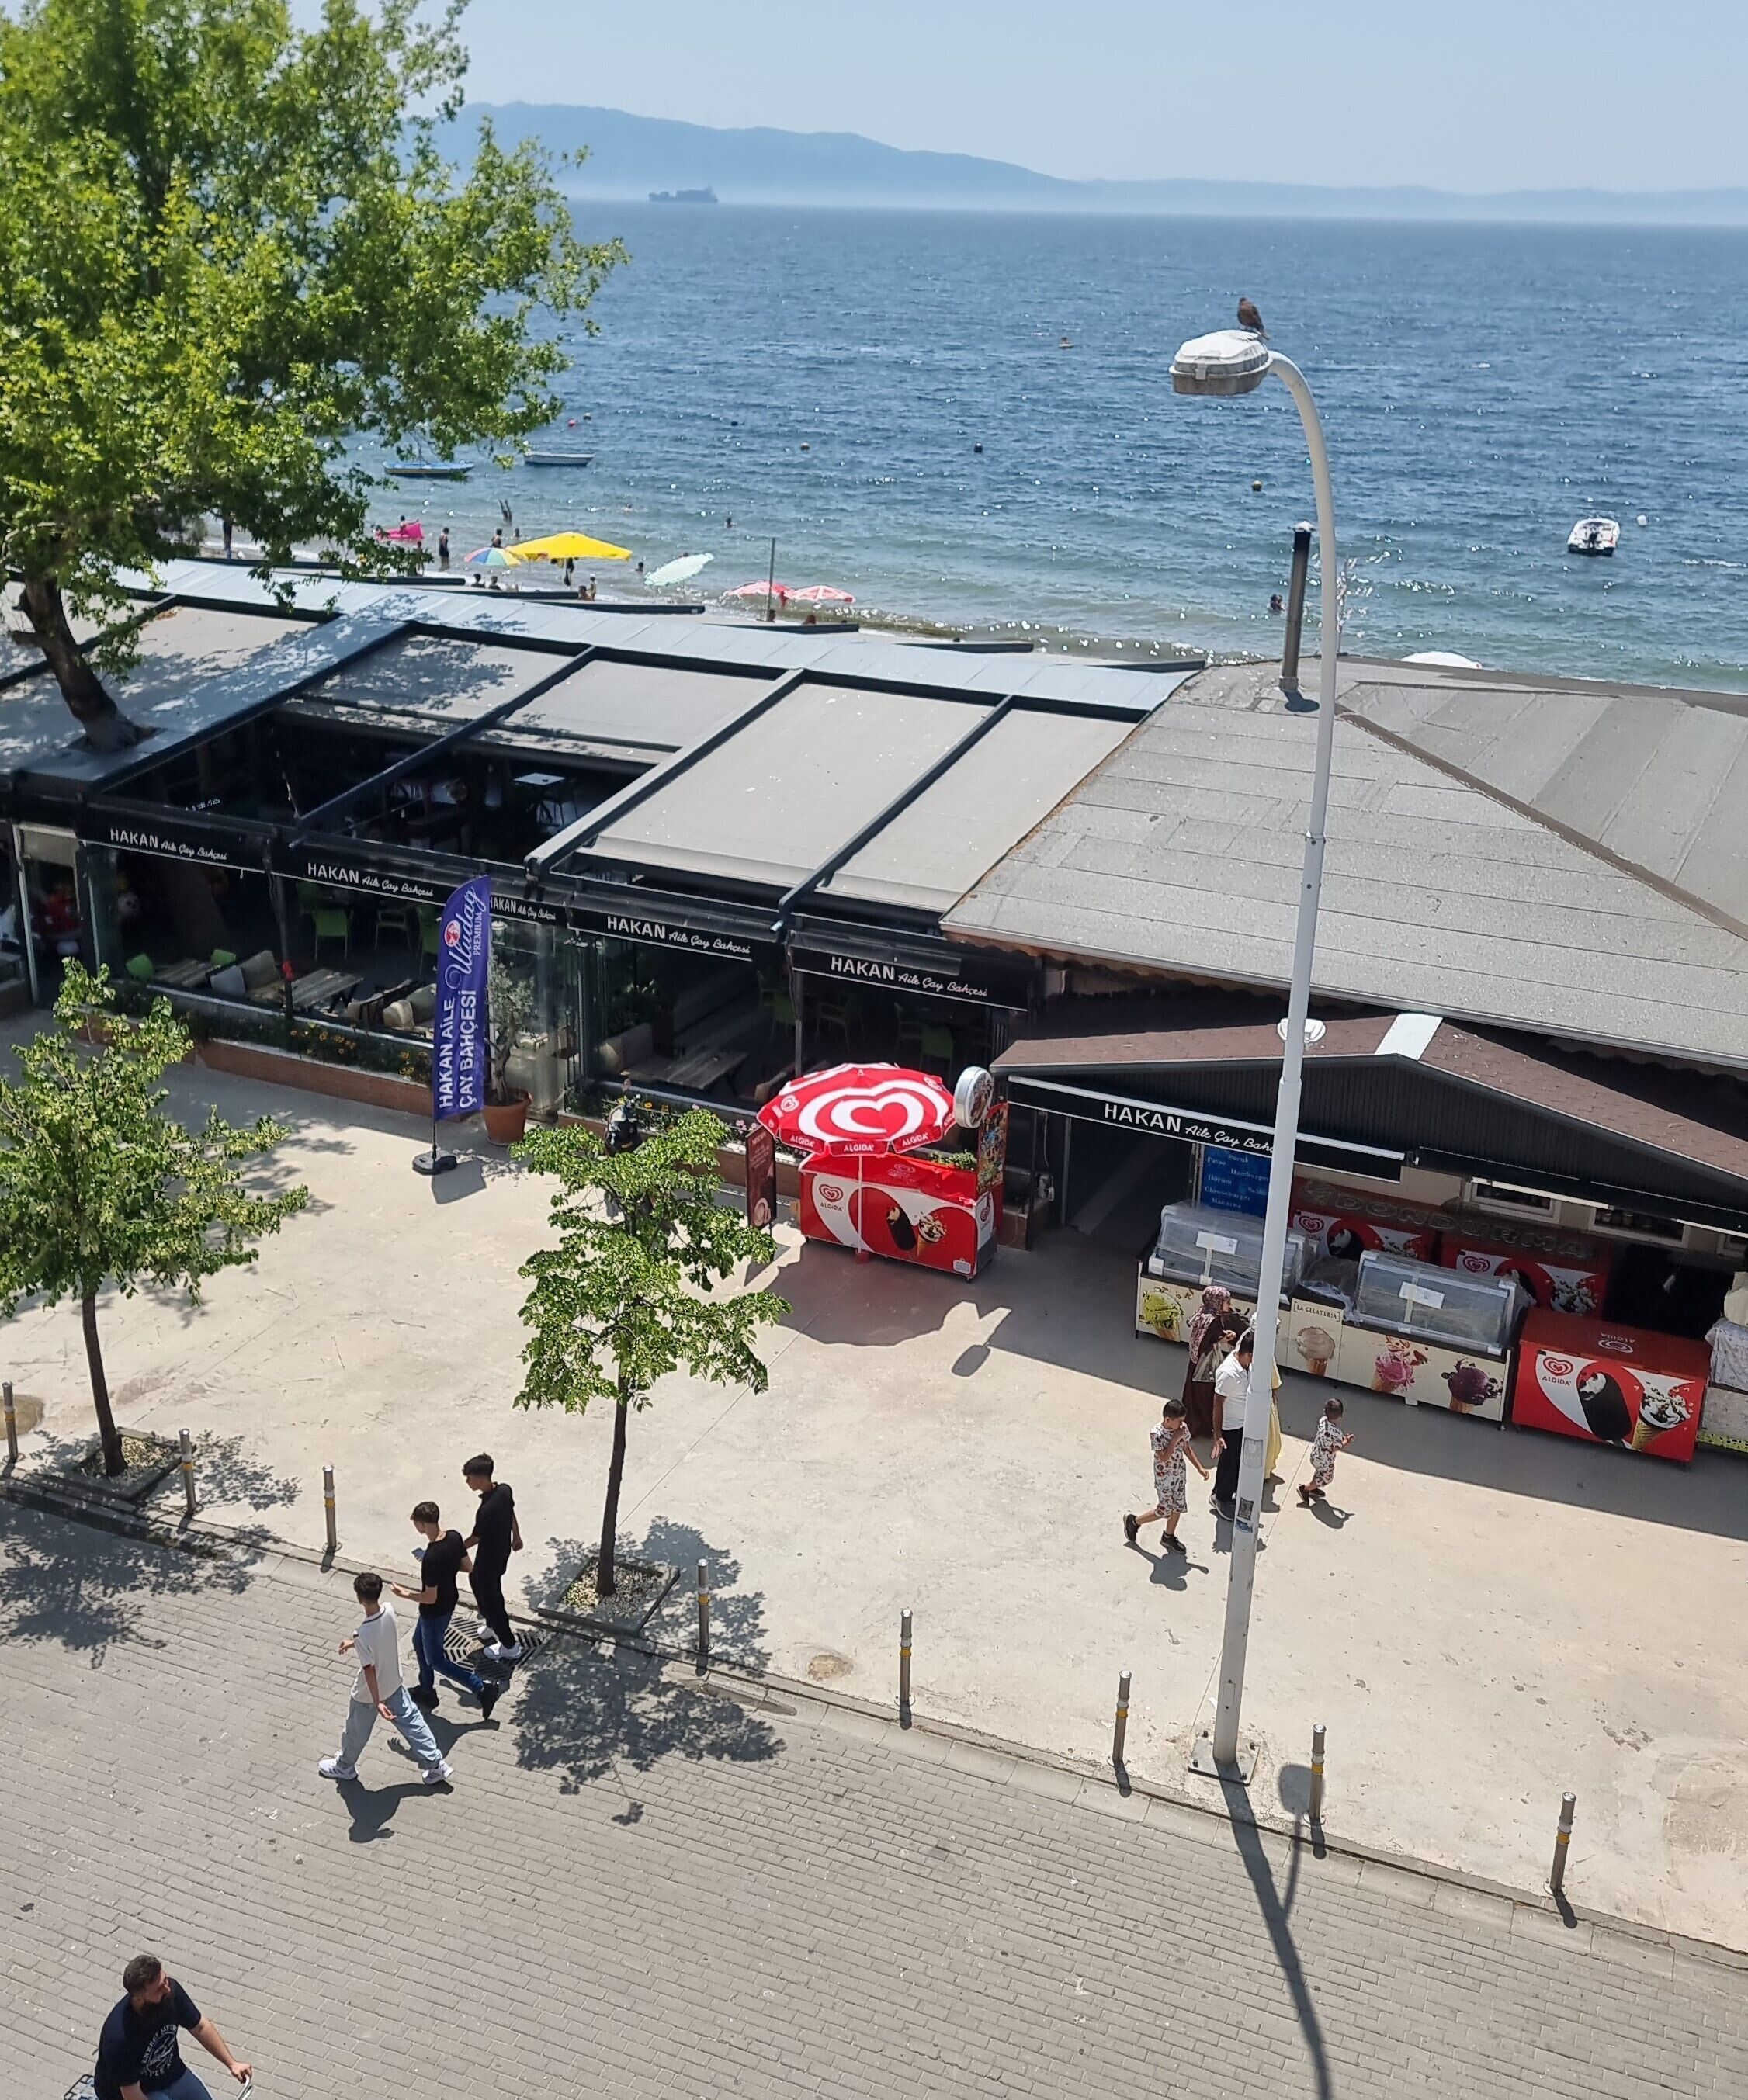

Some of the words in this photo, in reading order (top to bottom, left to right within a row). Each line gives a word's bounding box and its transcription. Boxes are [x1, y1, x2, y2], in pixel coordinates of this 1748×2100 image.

[110, 828, 158, 849] HAKAN
[307, 862, 359, 884] HAKAN
[362, 876, 380, 888] Aile
[473, 911, 483, 956] PREMIUM
[607, 915, 666, 939] HAKAN
[668, 931, 689, 944] Aile
[690, 935, 710, 949] Çay
[713, 938, 751, 955] Bahçesi
[831, 956, 895, 980] HAKAN
[898, 973, 921, 986] Aile
[922, 977, 944, 993] Çay
[946, 981, 988, 997] Bahçesi
[440, 997, 456, 1039] AİLE
[458, 989, 479, 1072] BAHÇESİ
[439, 1044, 453, 1109] HAKAN
[459, 1076, 477, 1109] ÇAY
[790, 1135, 815, 1148] ALGIDA
[902, 1133, 928, 1147] ALGIDA
[1104, 1103, 1181, 1133] HAKAN
[1185, 1125, 1212, 1139] Aile
[1214, 1131, 1240, 1147] Çay
[844, 1143, 872, 1152] ALGIDA
[820, 1202, 843, 1212] ALGIDA
[1542, 1375, 1571, 1387] ALGIDA
